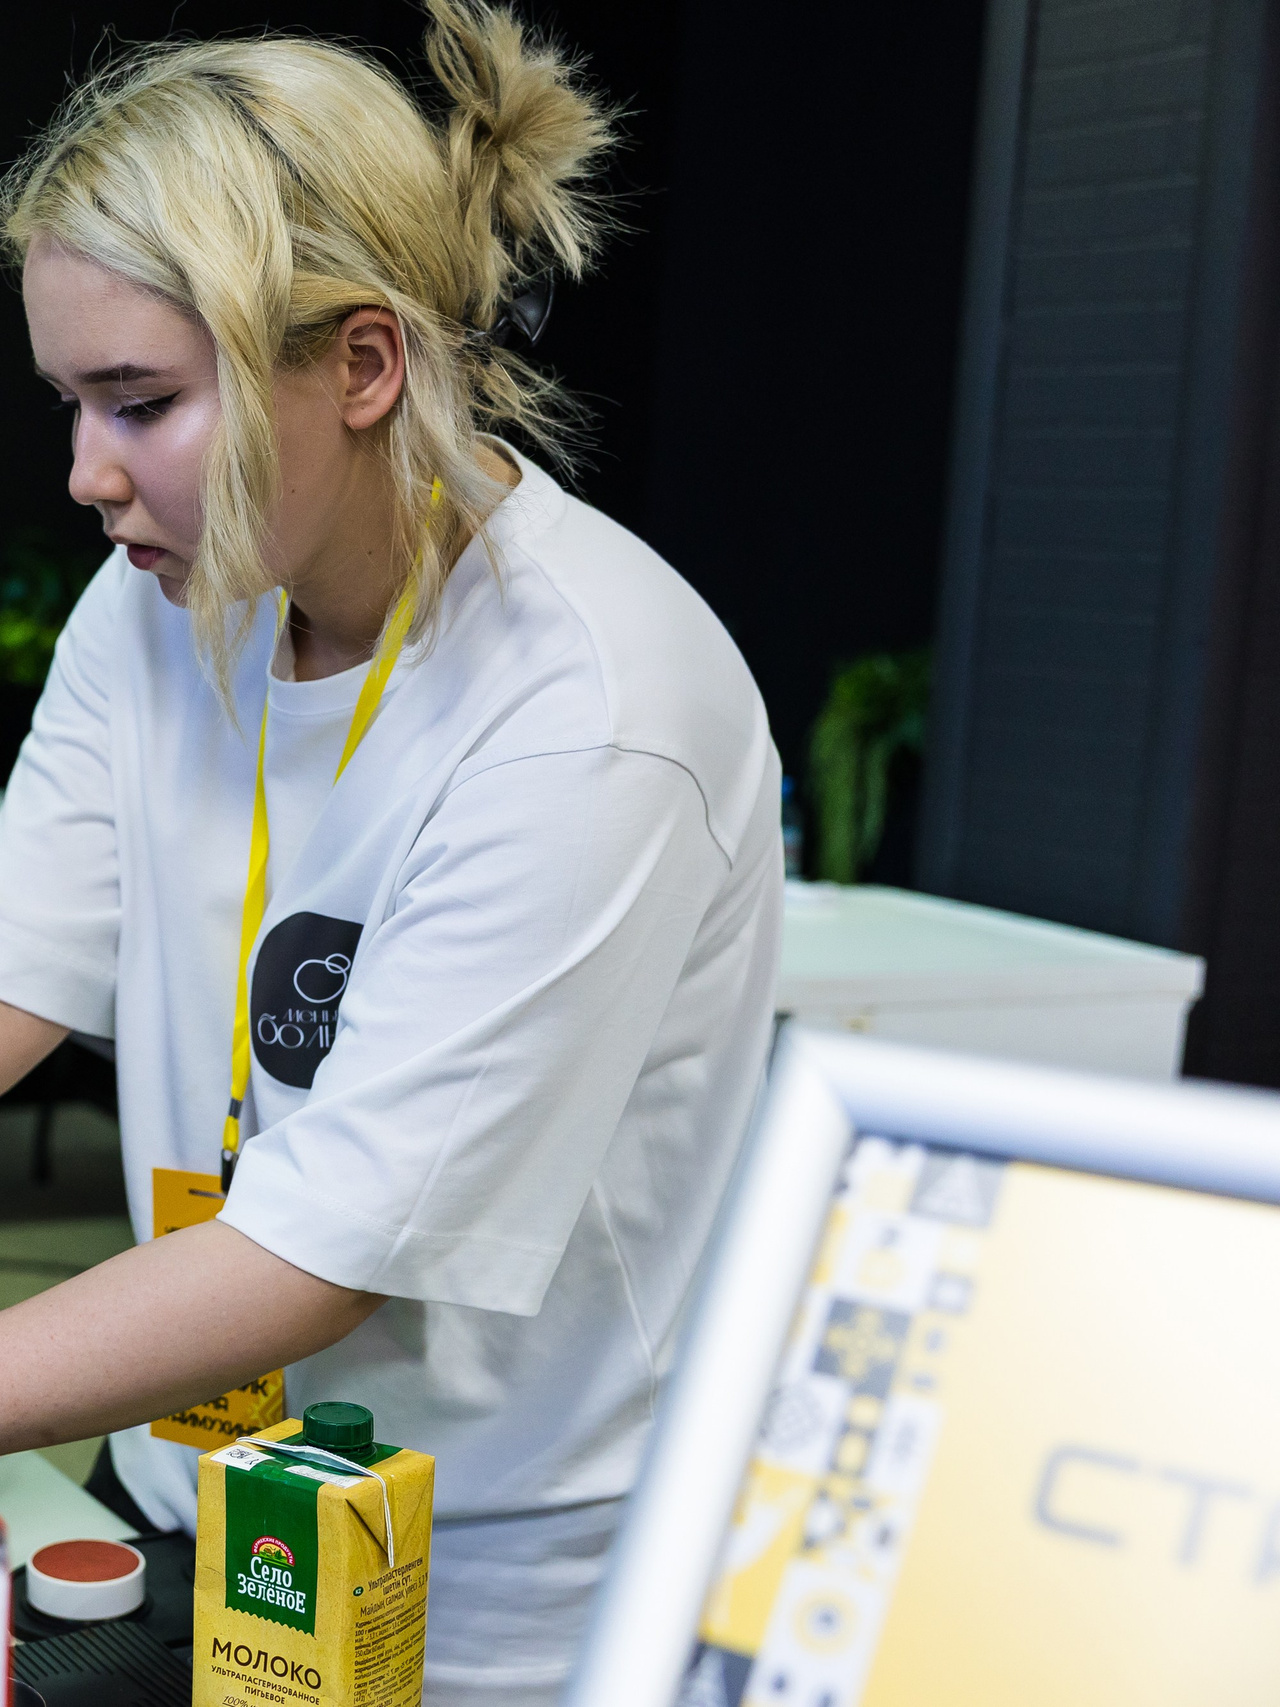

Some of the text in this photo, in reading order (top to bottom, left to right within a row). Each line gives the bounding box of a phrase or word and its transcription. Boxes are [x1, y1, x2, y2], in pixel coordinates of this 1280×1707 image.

[250, 1556, 292, 1588] Село
[211, 1637, 322, 1690] МОЛОКО
[211, 1665, 320, 1706] УЛЬТРАПАСТЕРИЗОВАННОЕ
[244, 1685, 286, 1705] ПИТЬЕВОЕ
